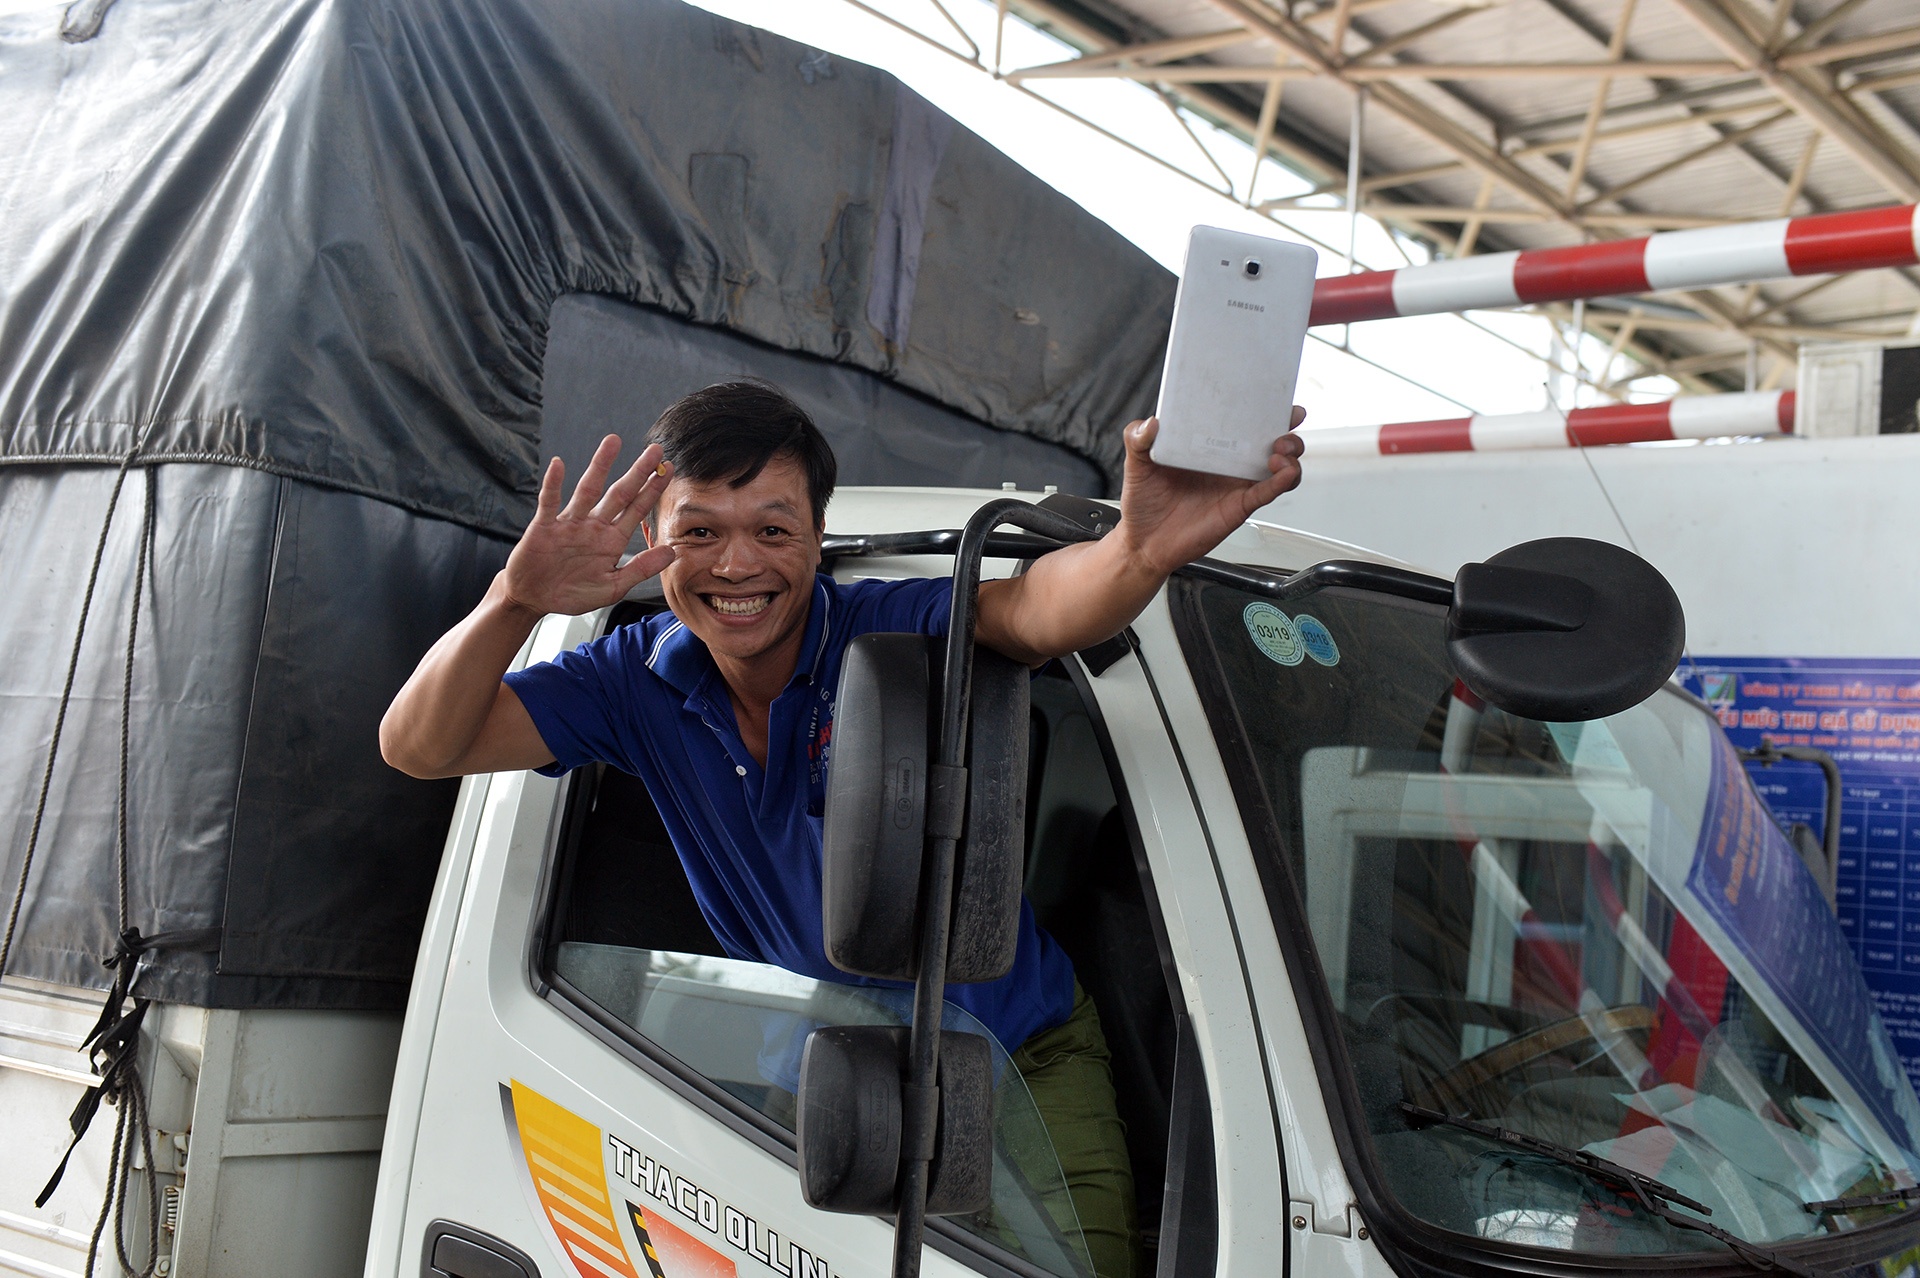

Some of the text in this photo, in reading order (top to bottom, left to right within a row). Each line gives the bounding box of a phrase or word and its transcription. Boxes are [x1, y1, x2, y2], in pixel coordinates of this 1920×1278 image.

[1227, 299, 1265, 313] SAMSUNG
[1256, 624, 1290, 641] 03/19
[1302, 630, 1329, 646] 03/18
[1782, 684, 1799, 698] TY
[1782, 710, 1817, 730] THU
[1819, 708, 1849, 731] GIÁ
[1880, 713, 1920, 735] DỤN
[608, 1132, 841, 1278] THACO OLLIN
